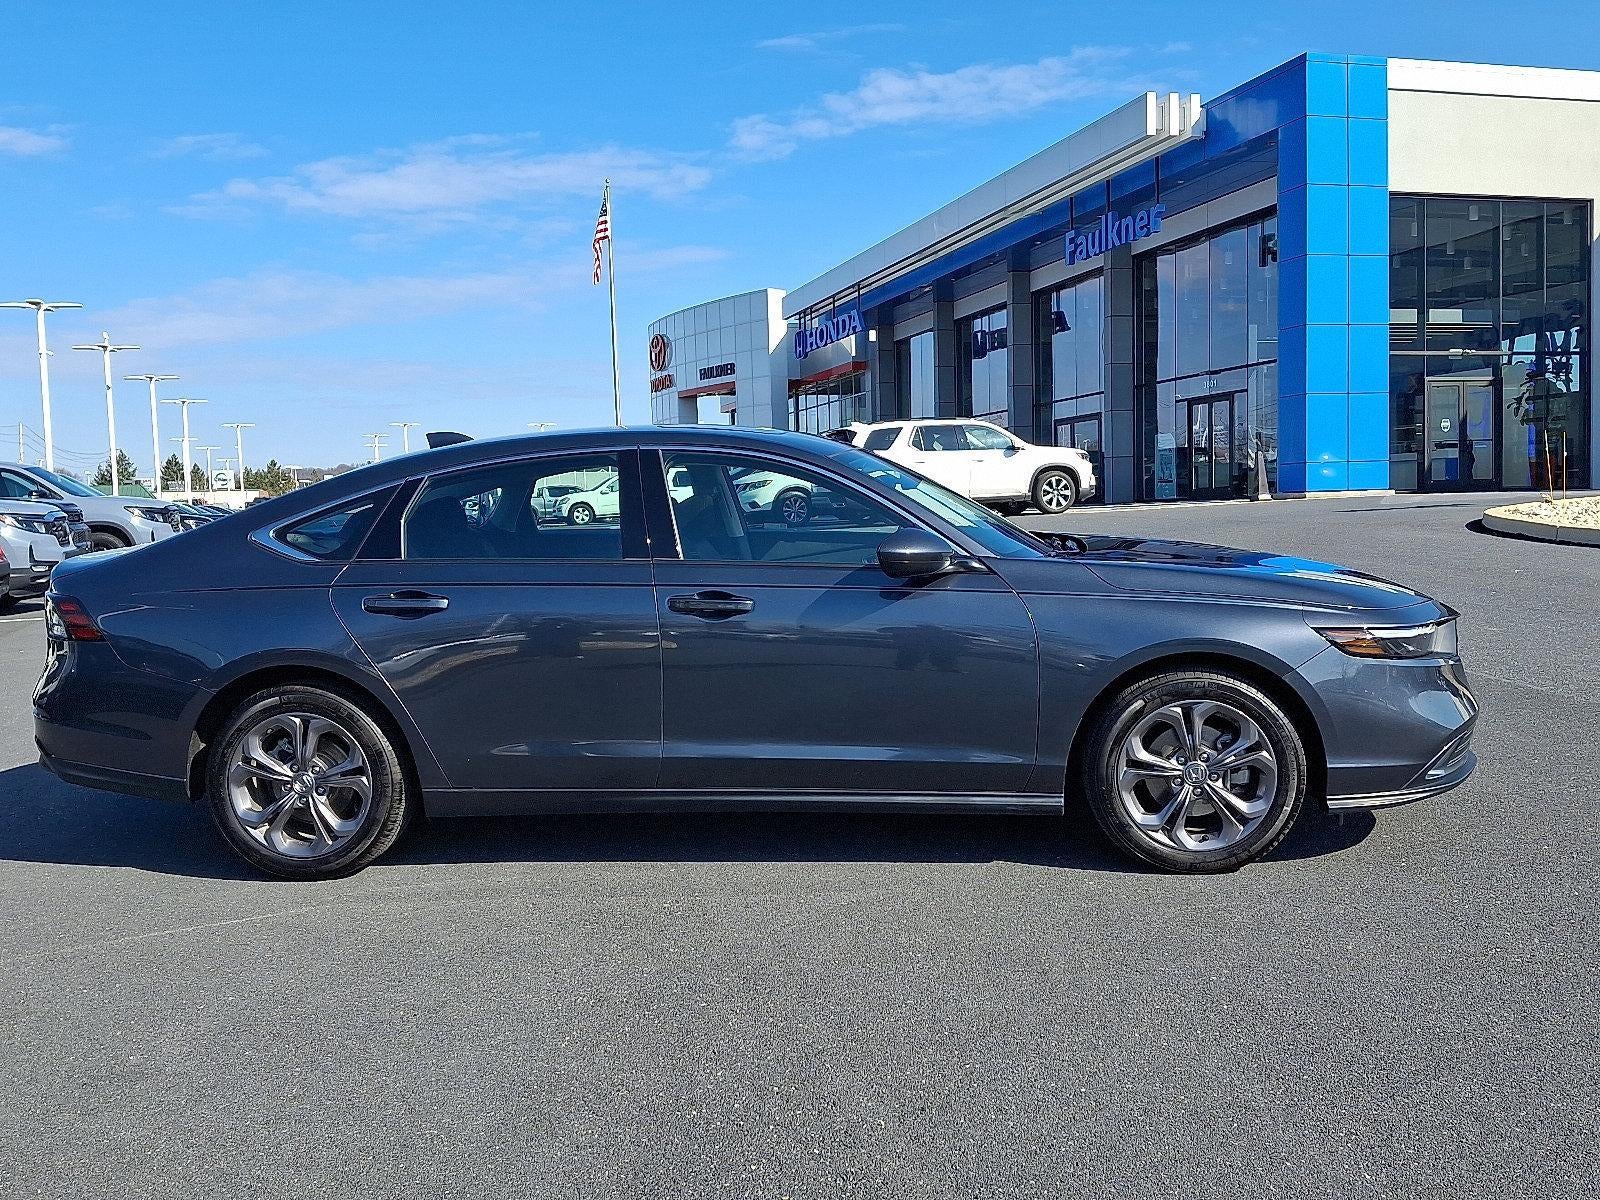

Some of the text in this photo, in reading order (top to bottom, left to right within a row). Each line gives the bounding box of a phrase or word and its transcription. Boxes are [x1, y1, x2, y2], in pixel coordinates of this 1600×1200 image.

[1065, 203, 1166, 266] Faulkner
[806, 309, 864, 352] HONDA
[699, 362, 736, 382] FAULKNER
